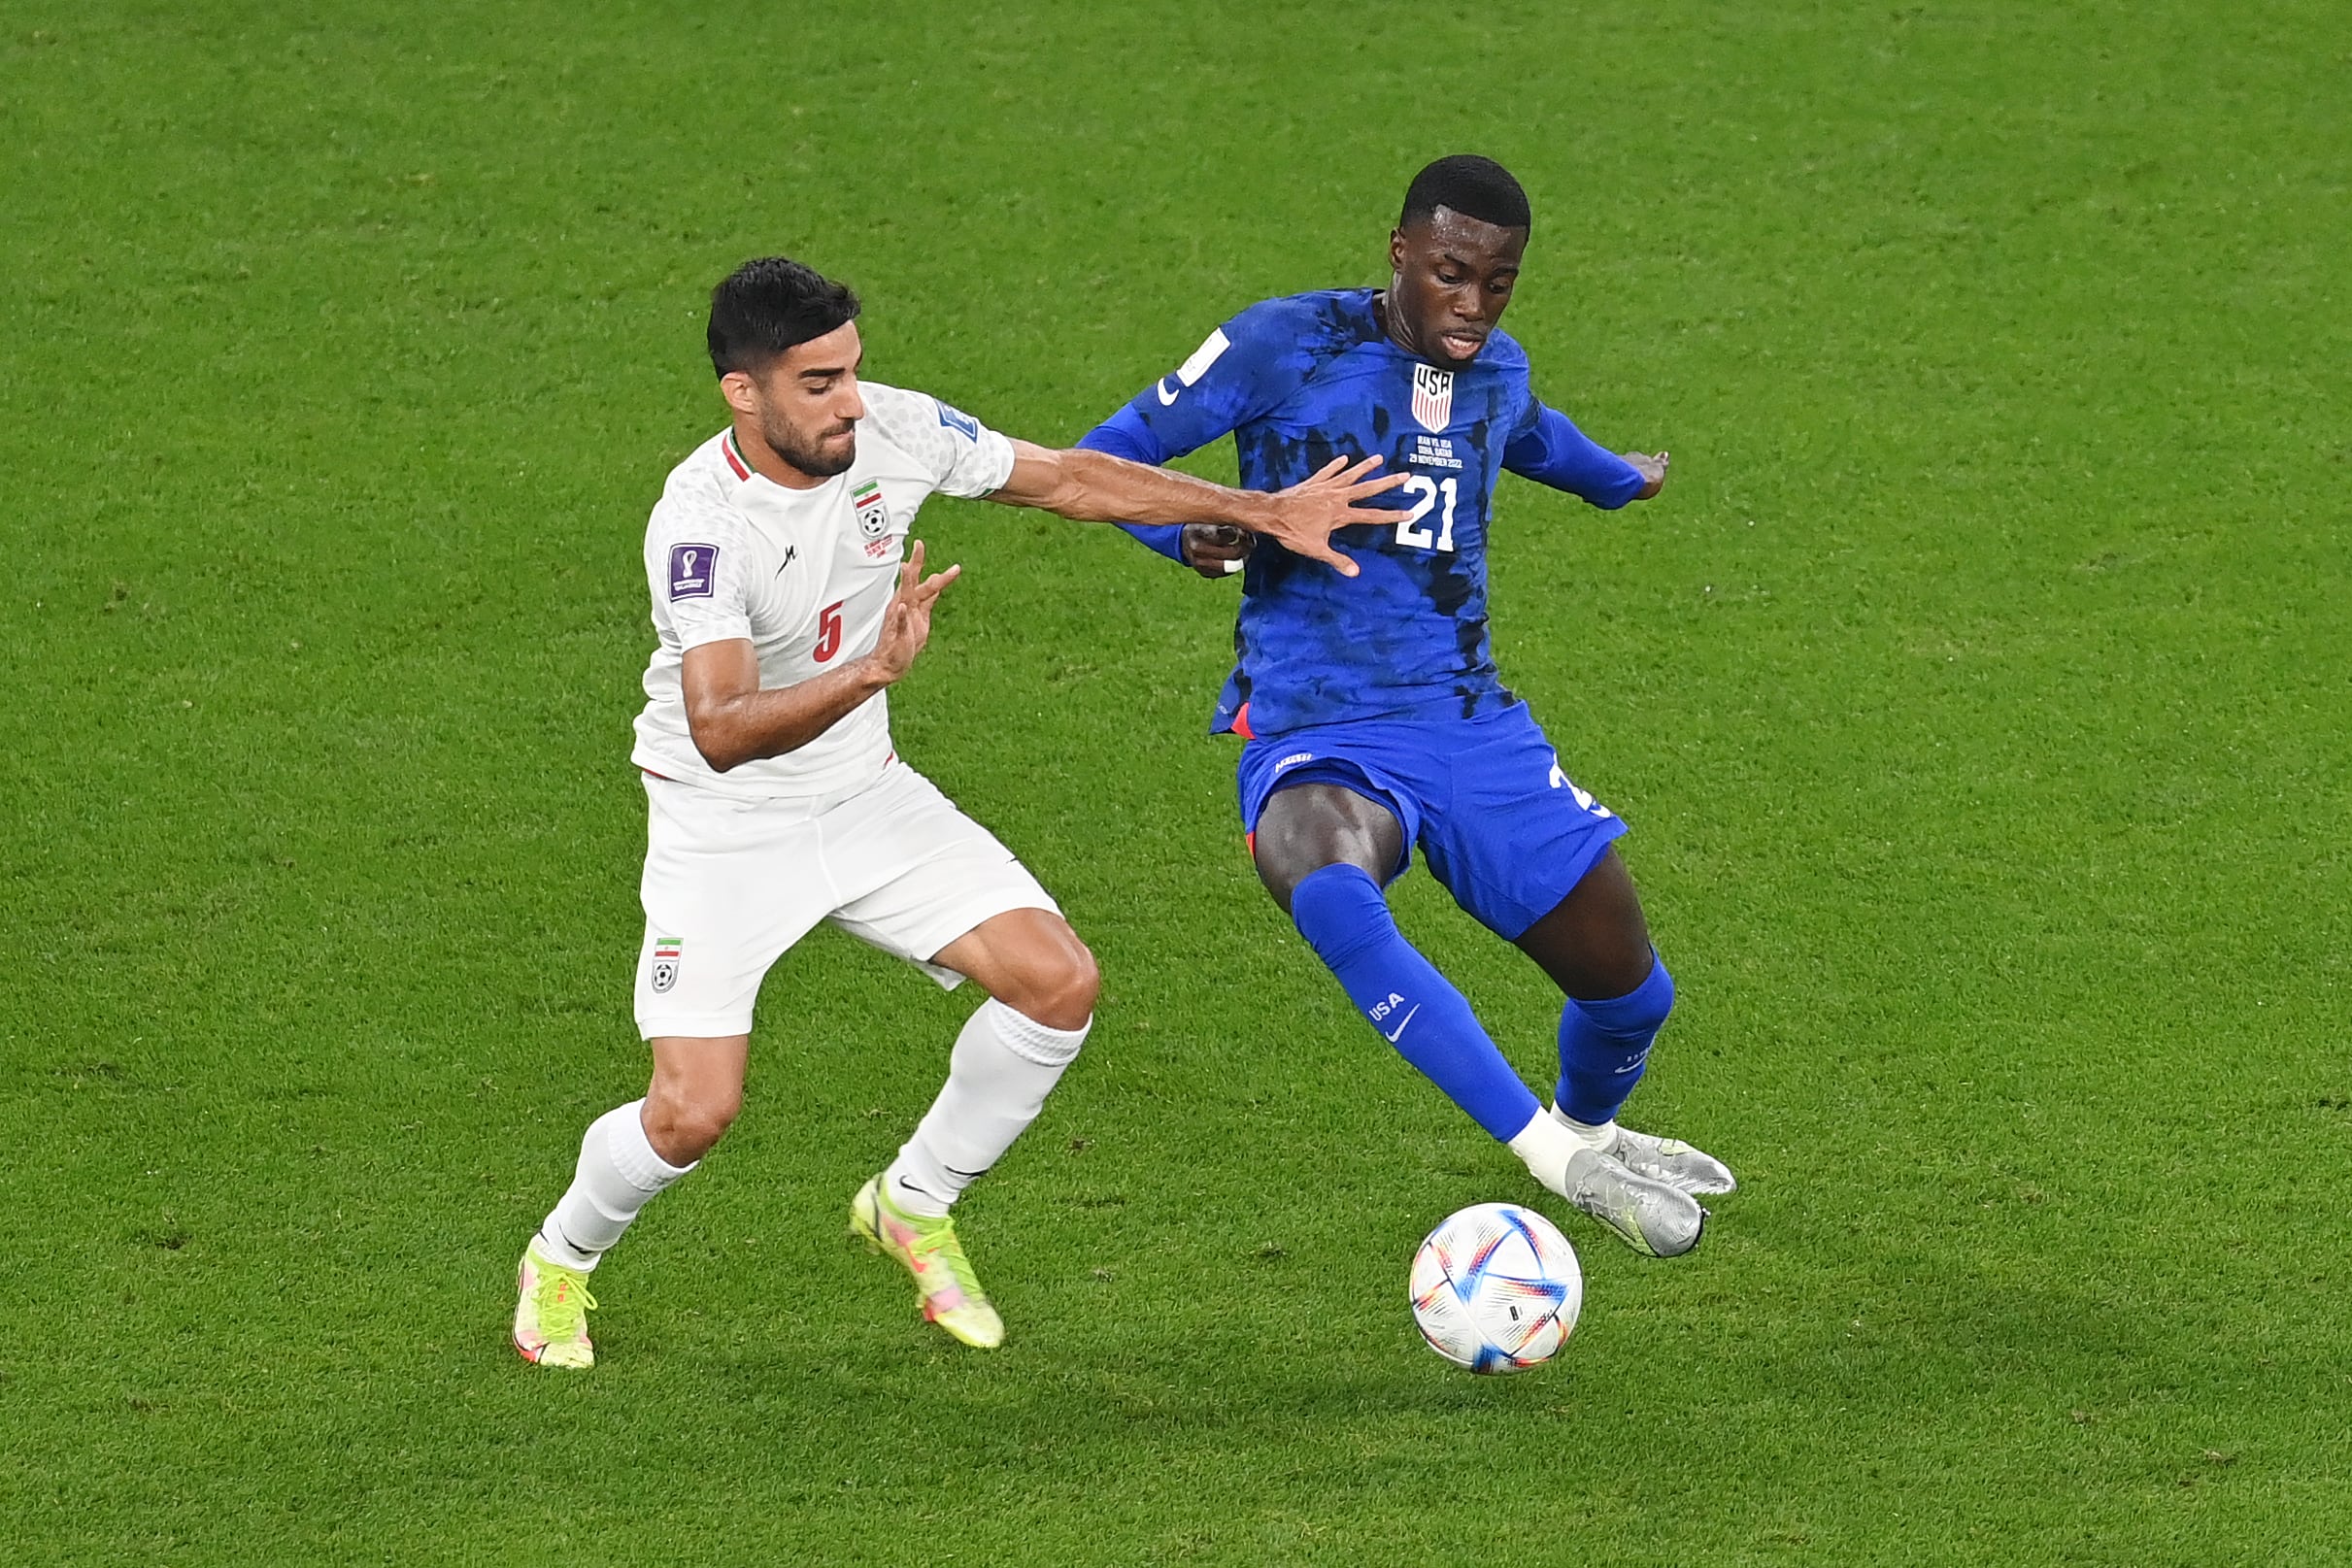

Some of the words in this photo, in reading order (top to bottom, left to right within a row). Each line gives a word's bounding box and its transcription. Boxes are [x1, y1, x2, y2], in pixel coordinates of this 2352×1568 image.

[1417, 367, 1451, 396] USA
[1395, 475, 1457, 551] 21
[813, 599, 844, 662] 5
[1368, 992, 1405, 1021] USA
